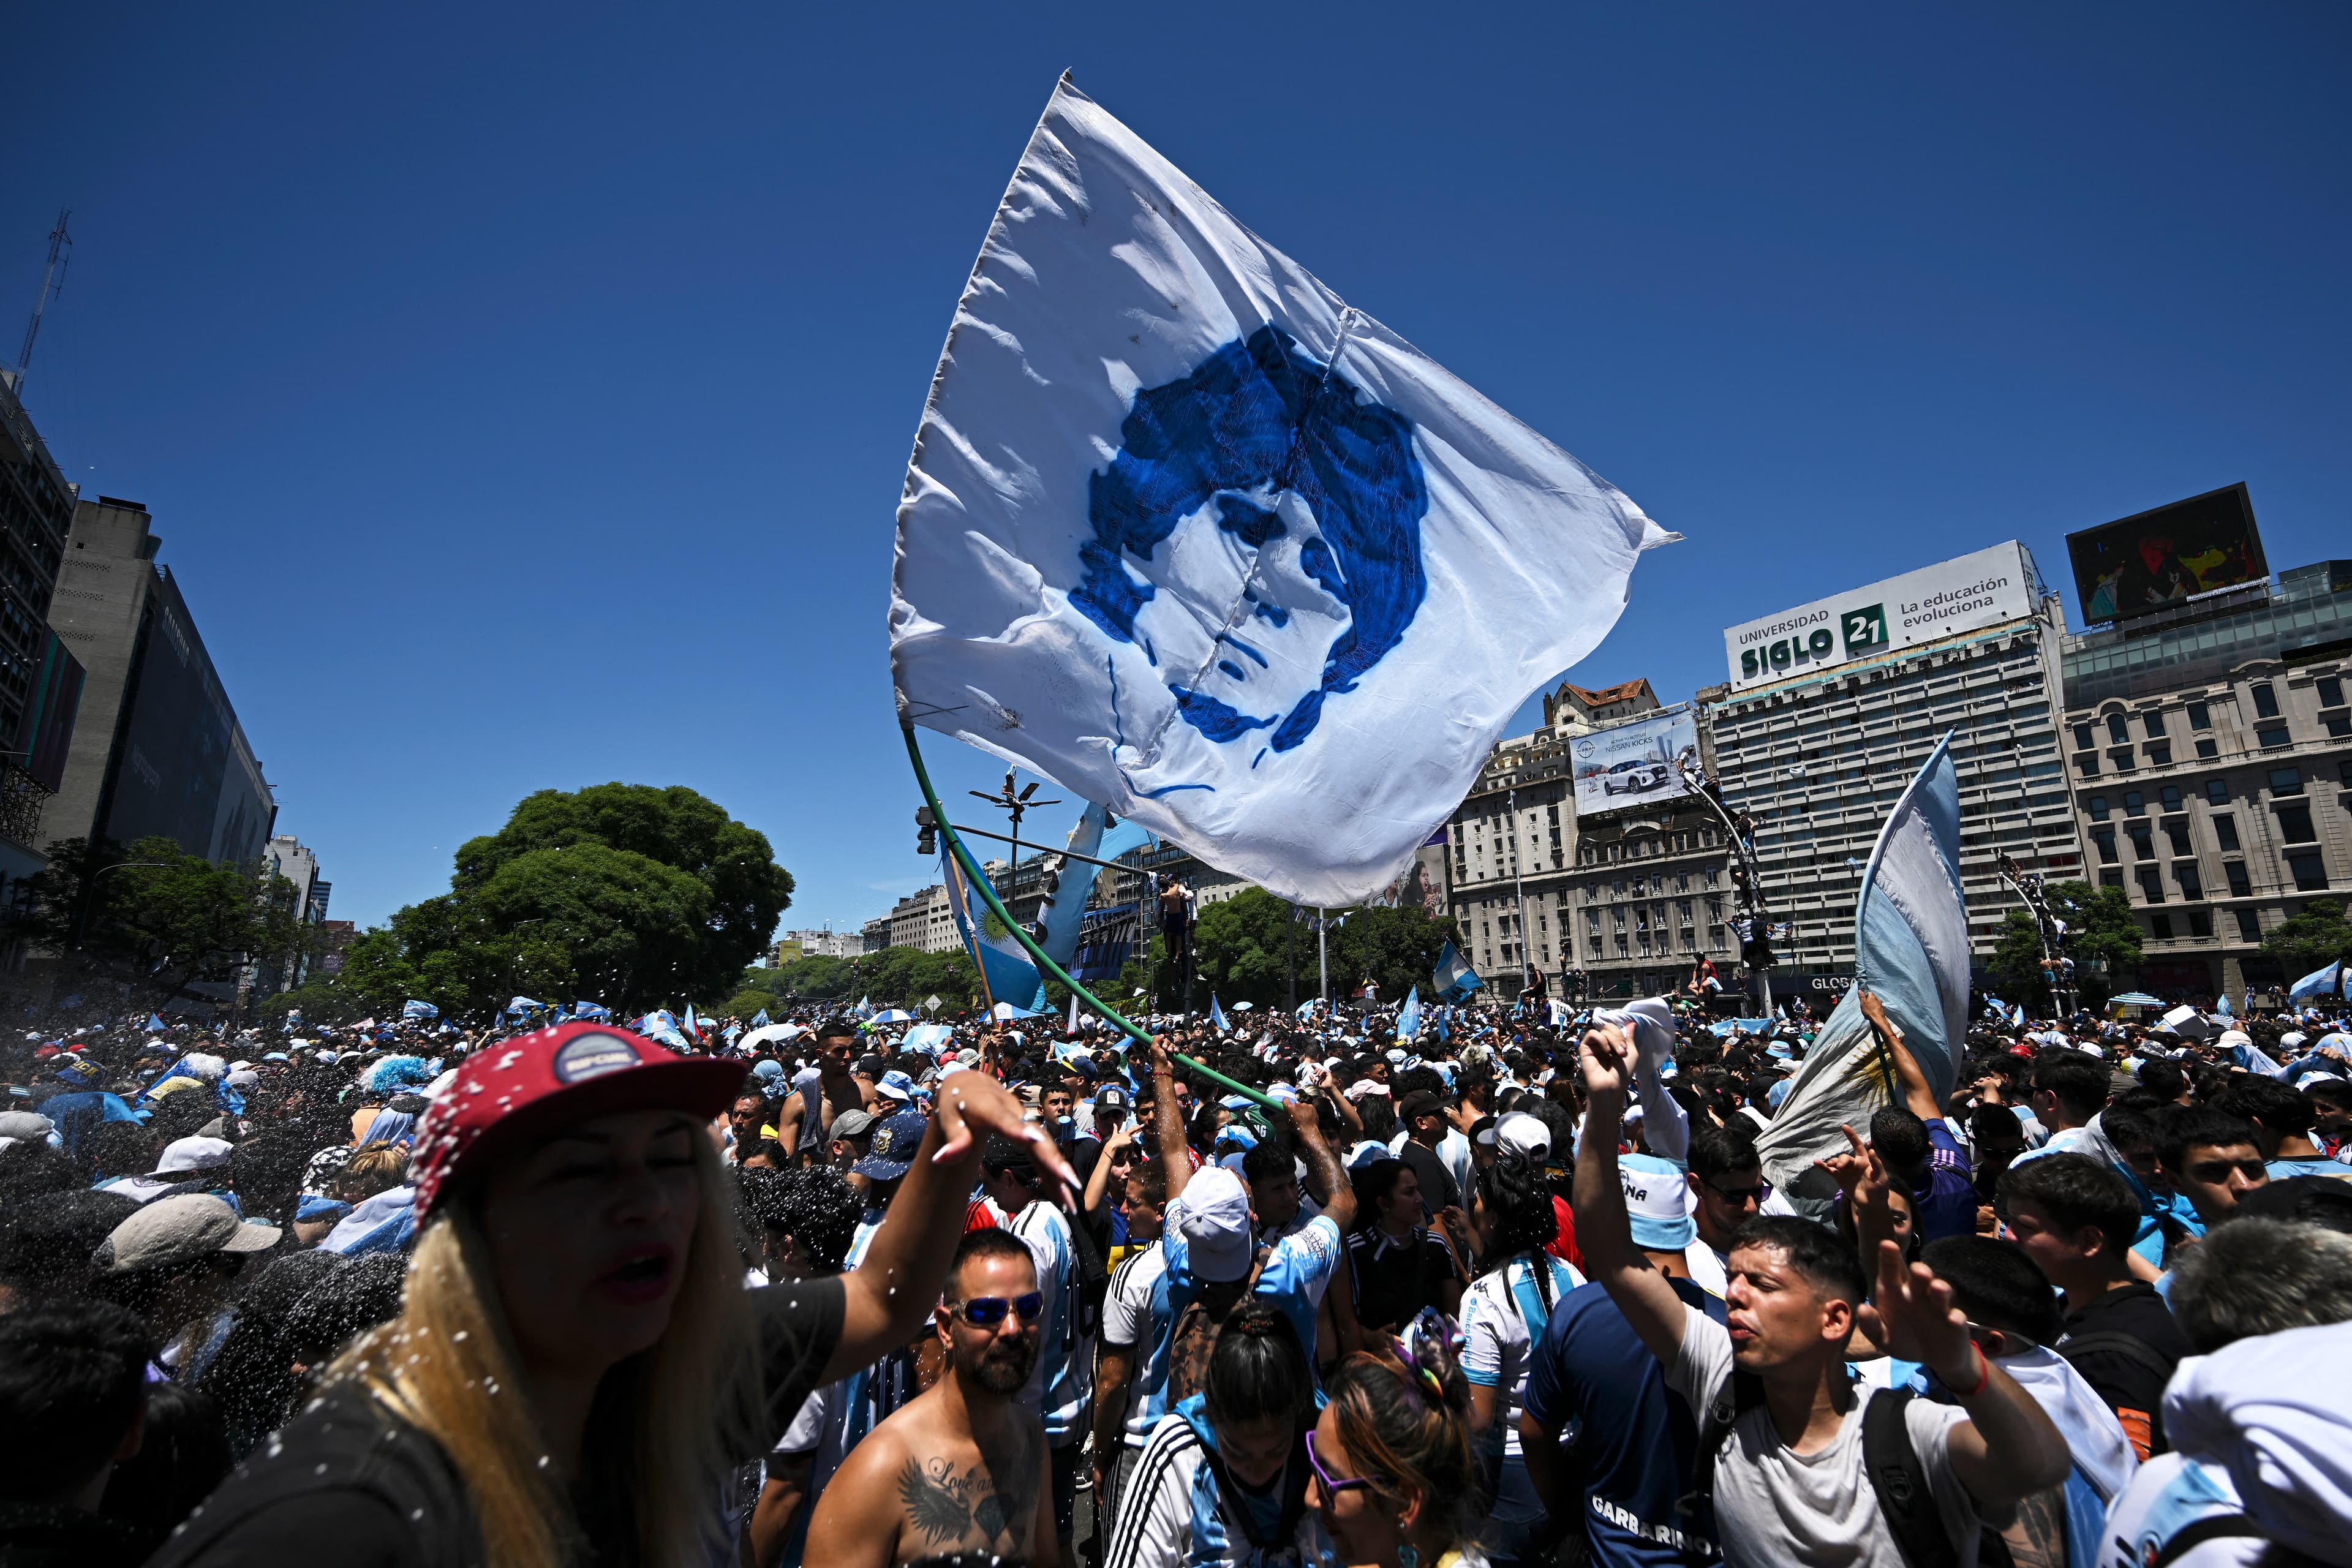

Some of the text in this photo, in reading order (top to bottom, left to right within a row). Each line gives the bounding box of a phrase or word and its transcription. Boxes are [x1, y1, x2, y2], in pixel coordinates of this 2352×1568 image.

[1901, 576, 2008, 615] La educación
[1903, 595, 1994, 628] evoluciona
[162, 606, 189, 669] SAMSUNG
[1740, 610, 1829, 644] UNIVERSIDAD
[1741, 616, 1879, 673] SIGLO 21
[1576, 745, 1596, 754] NISSAN
[1605, 736, 1653, 753] NISSAN KICKS
[1556, 1004, 1566, 1015] 10
[74, 1060, 99, 1077] OCA
[1625, 1184, 1648, 1202] NA
[928, 1456, 1000, 1493] Love an
[1592, 1494, 1712, 1556] GARBARINO
